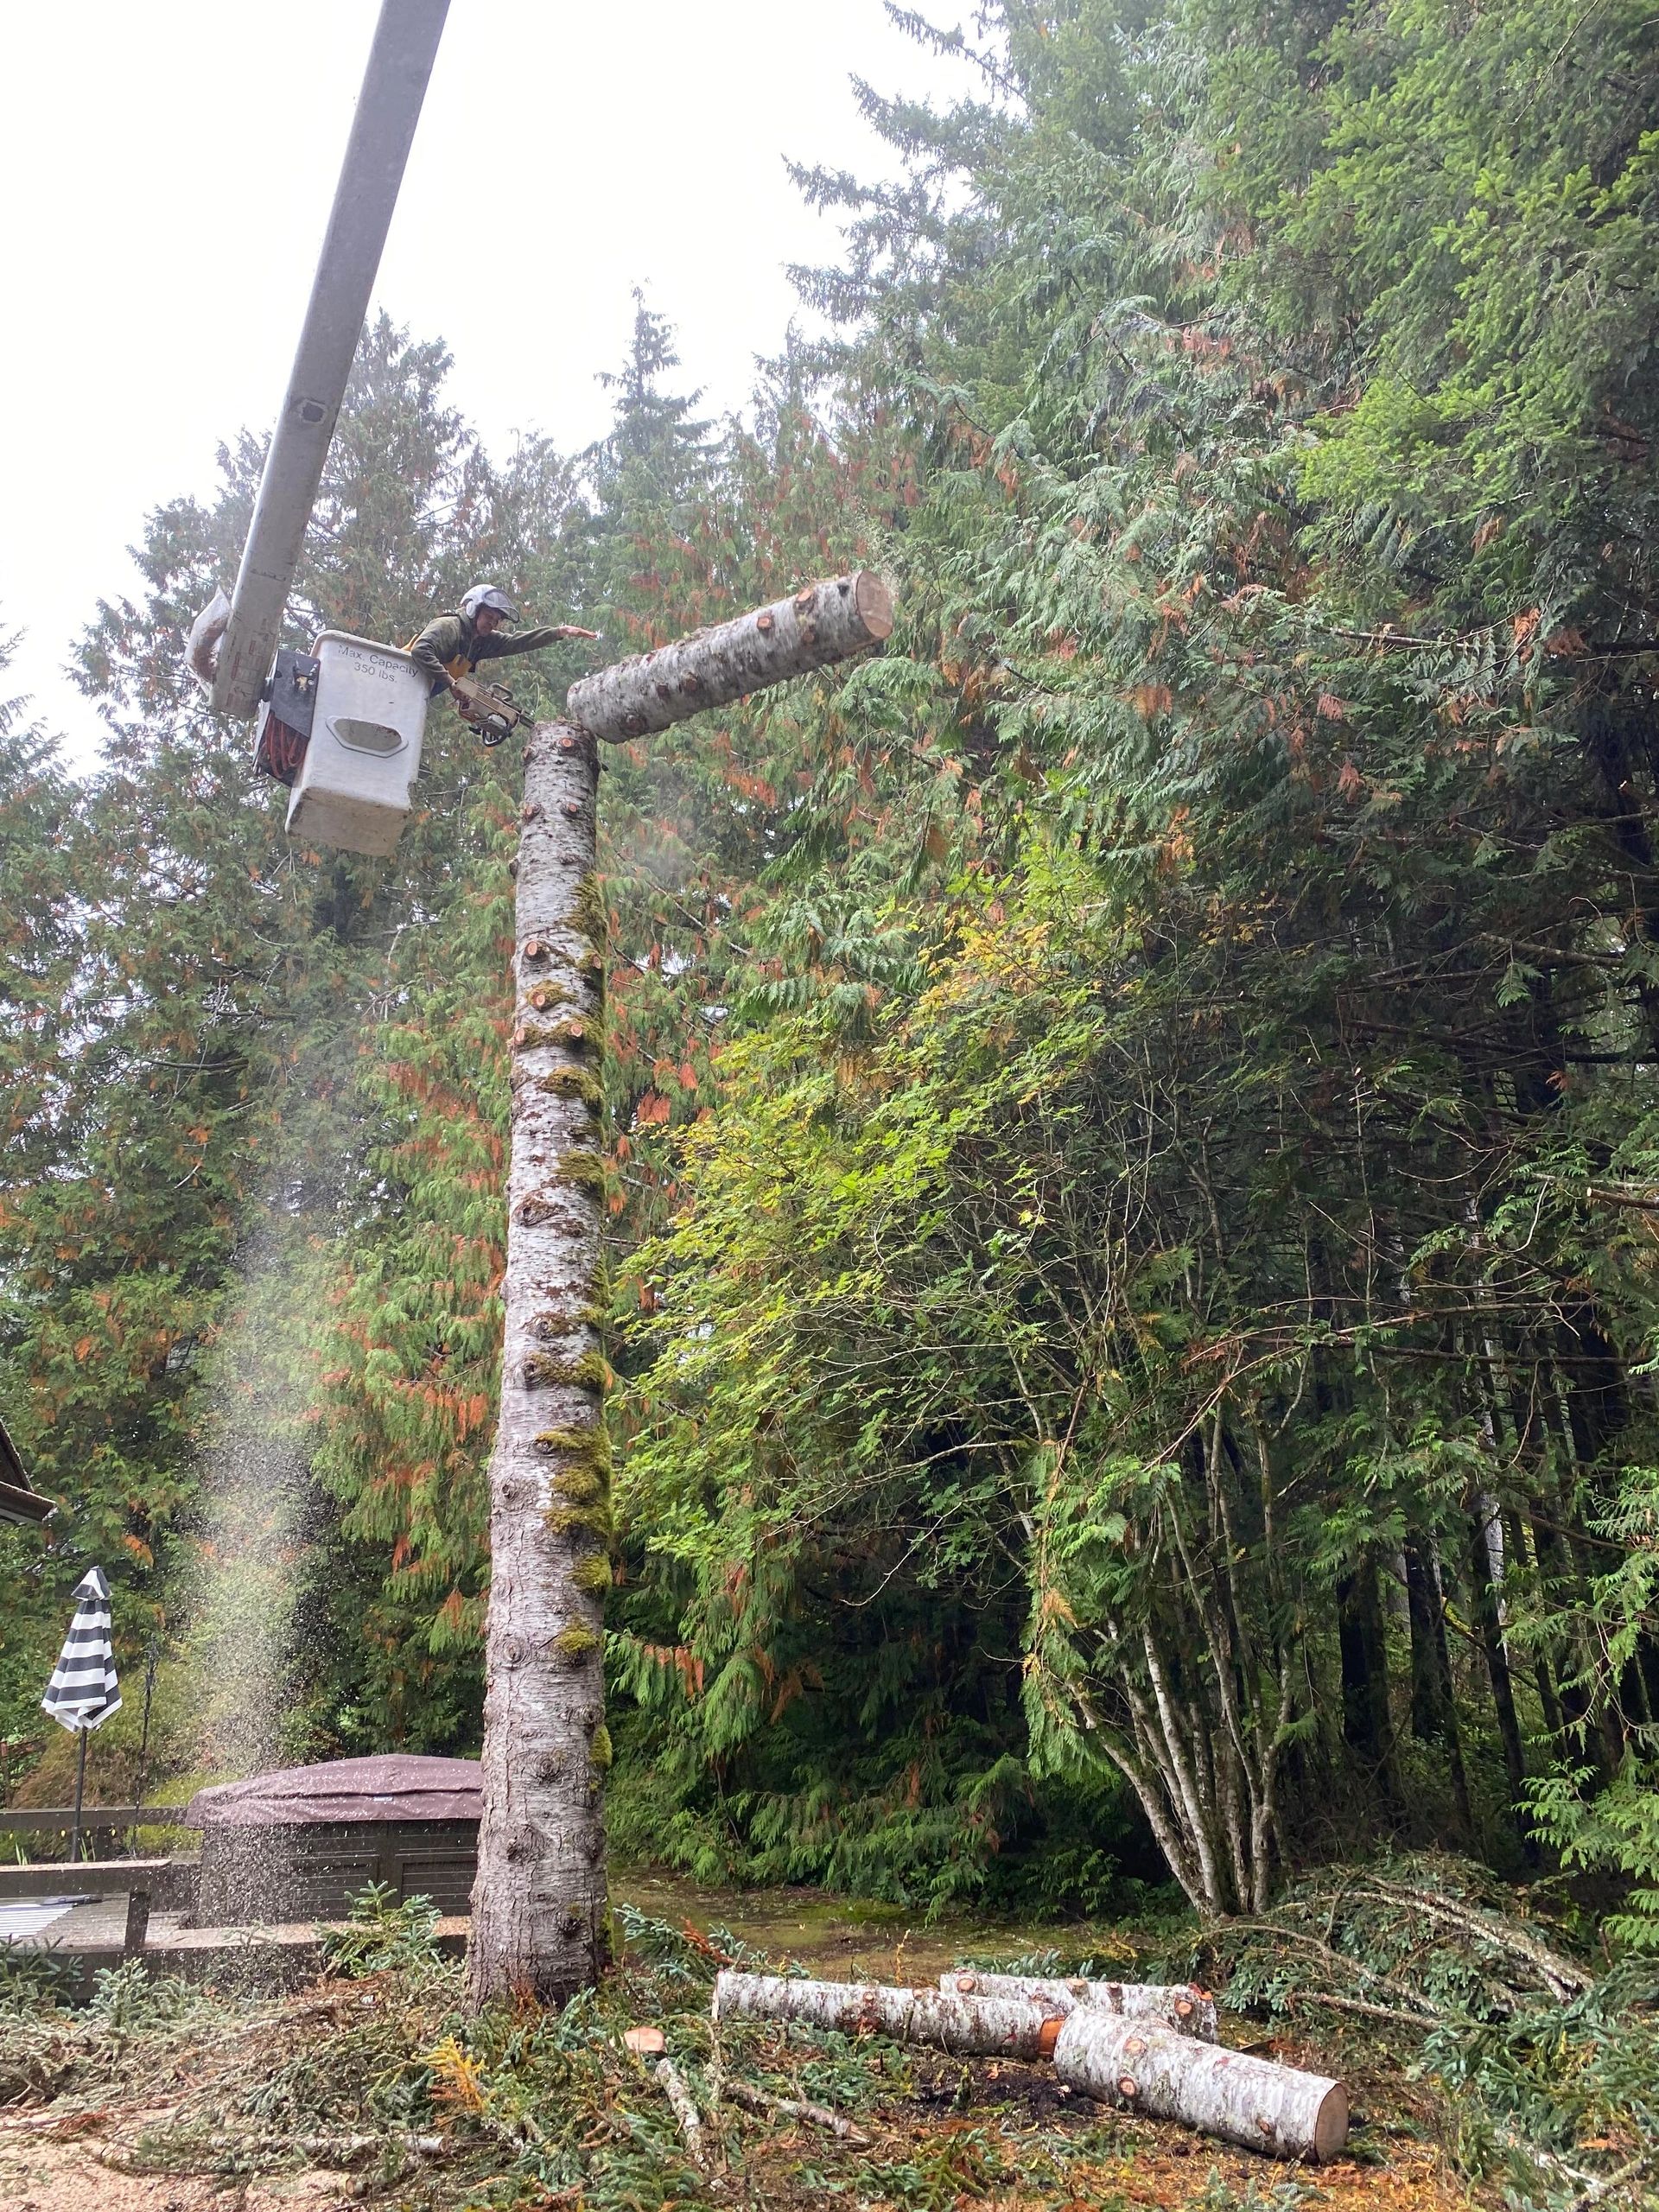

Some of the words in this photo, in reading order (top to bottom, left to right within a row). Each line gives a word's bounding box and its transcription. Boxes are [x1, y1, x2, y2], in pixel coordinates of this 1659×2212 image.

[338, 644, 365, 661] Max.
[369, 654, 419, 678] Capacity
[353, 661, 375, 676] 350
[378, 670, 397, 683] lbs.
